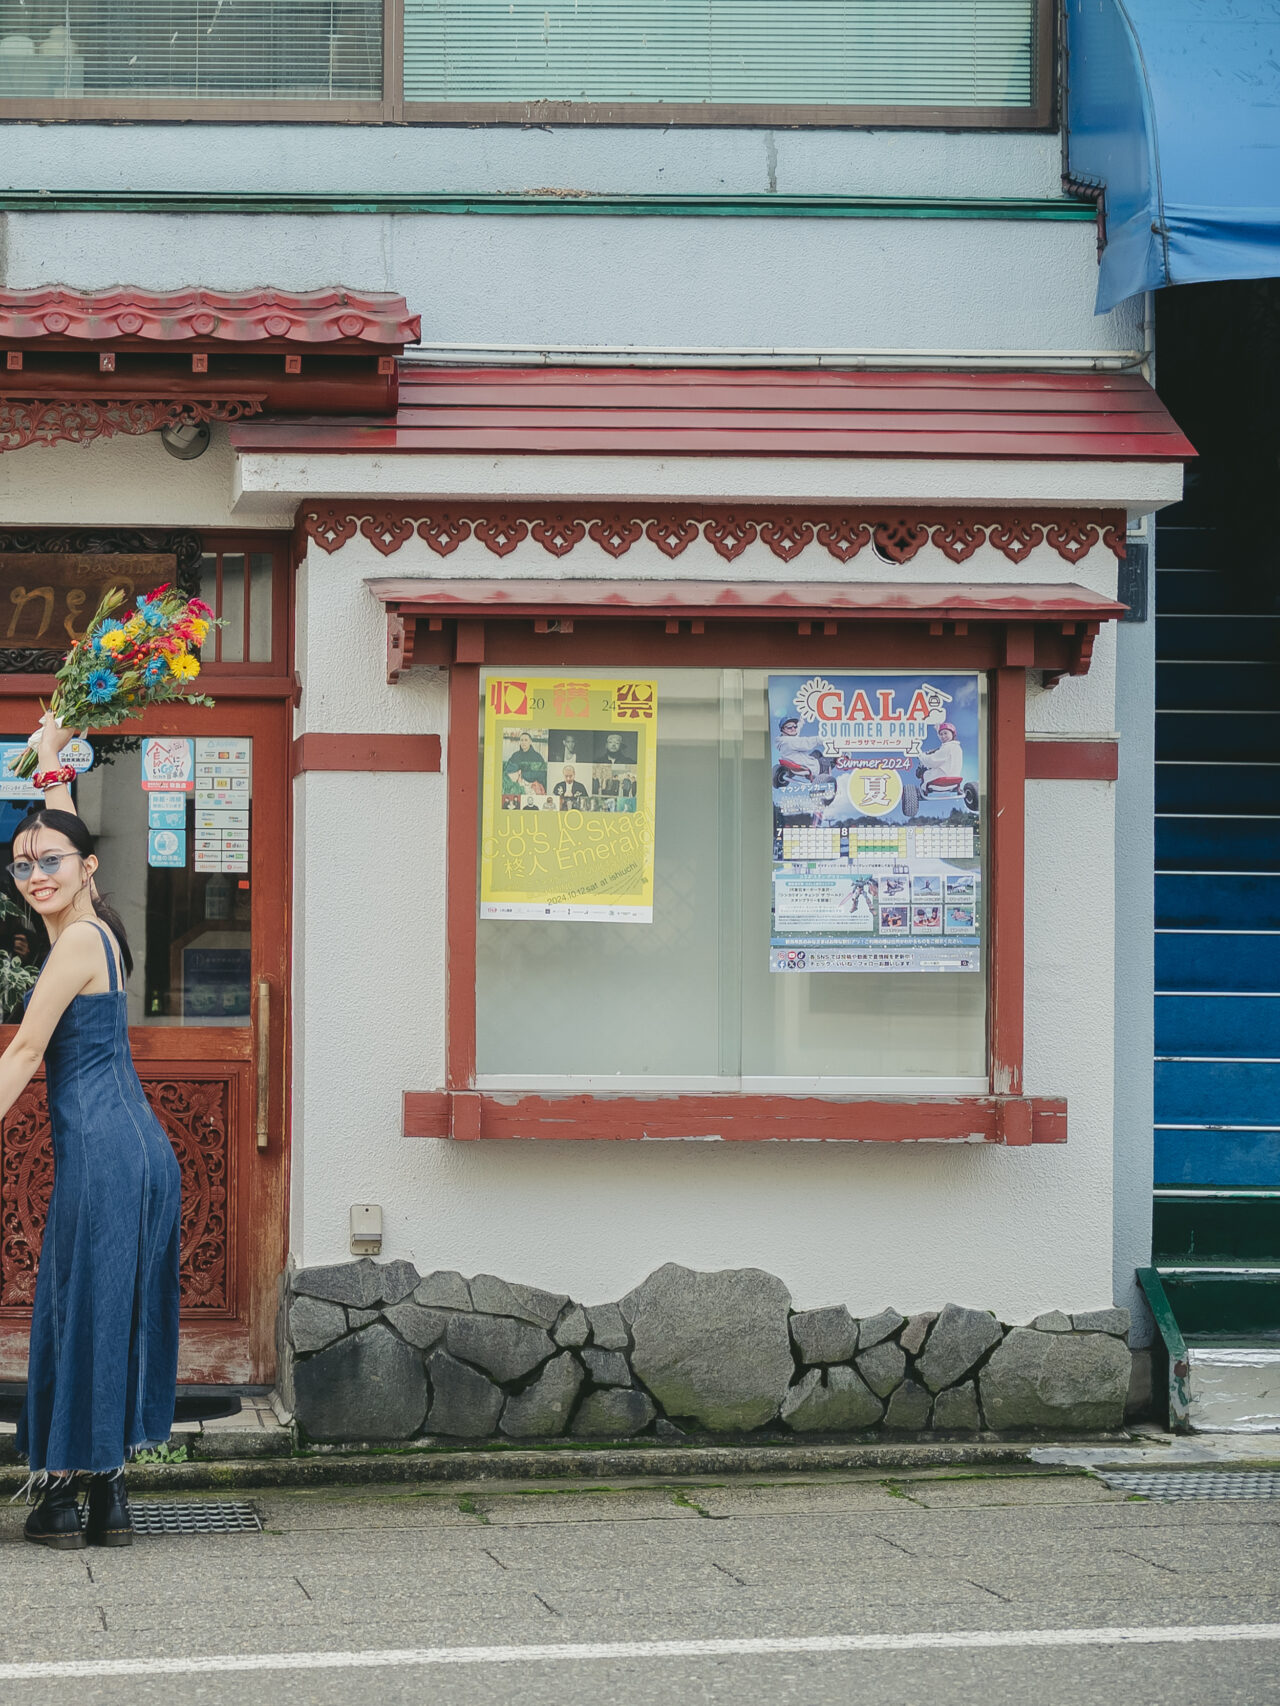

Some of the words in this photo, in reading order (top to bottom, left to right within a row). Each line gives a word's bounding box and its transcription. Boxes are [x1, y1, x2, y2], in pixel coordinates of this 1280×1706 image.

[529, 697, 545, 710] 20
[601, 699, 617, 712] 24
[816, 692, 930, 721] GALA
[820, 723, 883, 737] SUMMER
[889, 722, 926, 737] PARK
[836, 757, 881, 770] Summer
[880, 757, 912, 770] 2024
[859, 773, 891, 808] 夏
[498, 814, 538, 837] JJJ
[776, 827, 783, 837] 7
[841, 827, 848, 836] 8
[599, 877, 609, 886] at
